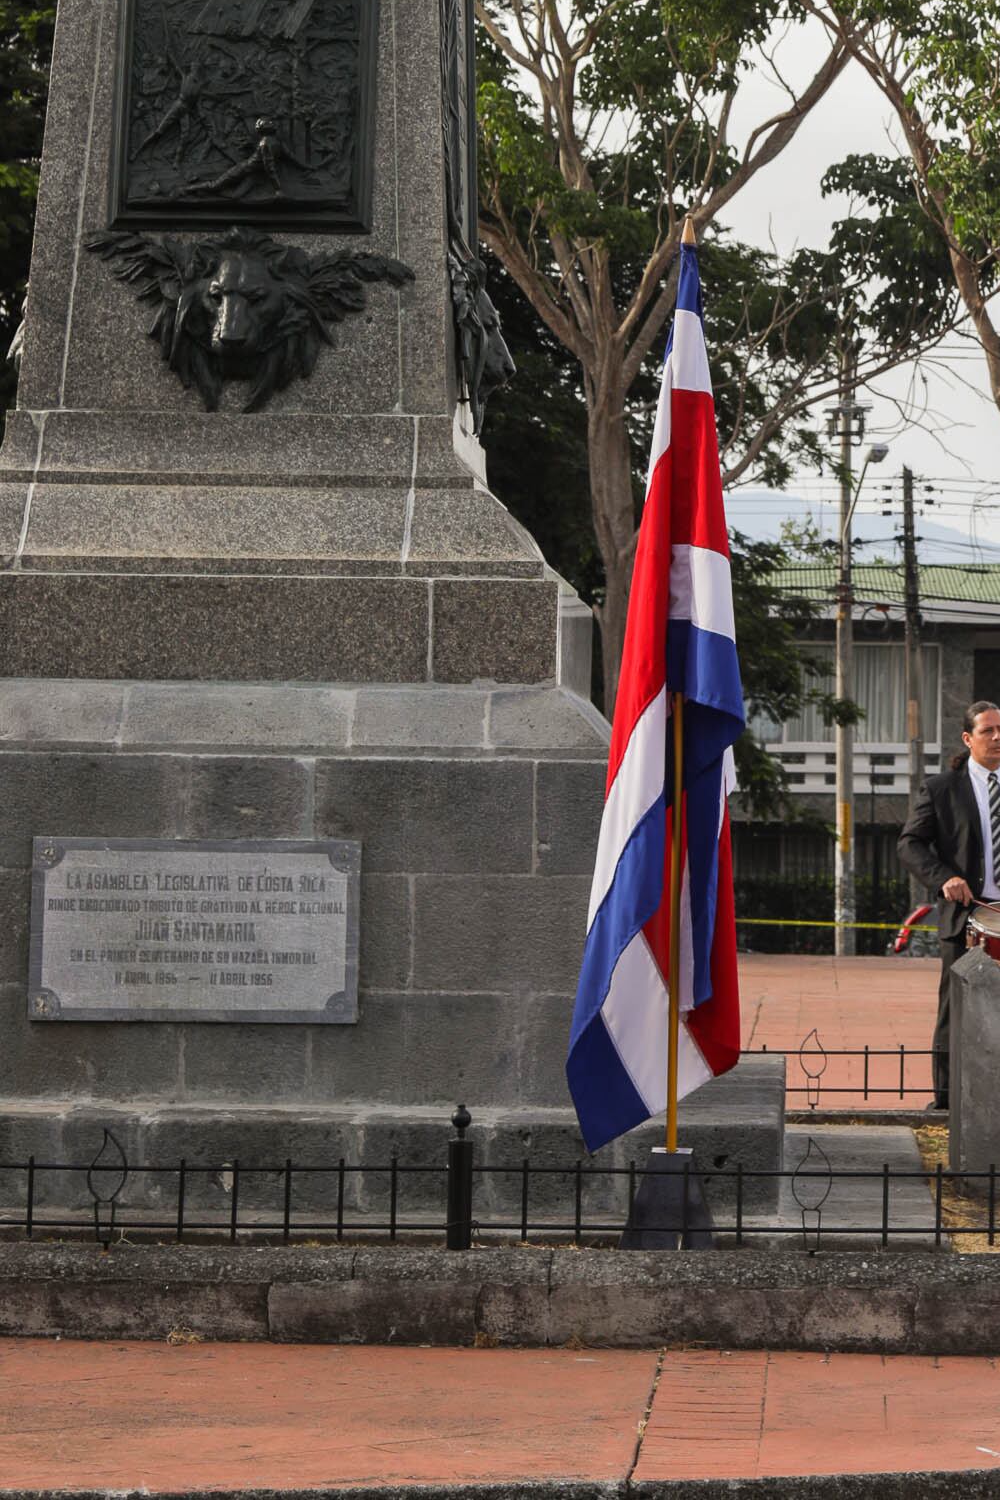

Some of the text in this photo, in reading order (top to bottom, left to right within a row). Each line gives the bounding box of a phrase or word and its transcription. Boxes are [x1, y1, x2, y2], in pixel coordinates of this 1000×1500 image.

[66, 873, 326, 892] LA ASAMBLEA LEGISLATIVA DE COSTA RICA
[48, 898, 77, 911] RINDE
[79, 898, 140, 912] EMOCIONADO
[144, 899, 183, 913] TRIBUTO
[185, 900, 198, 913] DE
[200, 900, 248, 914] GRATITUD
[250, 901, 263, 913] AL
[299, 901, 345, 915] NACIONAL
[135, 919, 256, 942] JUAN SANTAMARIA
[70, 949, 83, 962] EN
[85, 949, 97, 962] EL
[100, 950, 137, 963] PRIMER
[202, 951, 214, 964] DE
[216, 951, 230, 964] SU
[272, 952, 318, 965] INMORTAL
[124, 972, 152, 984] ABRIL
[219, 972, 248, 986] ABRIL
[250, 973, 273, 986] 1956
